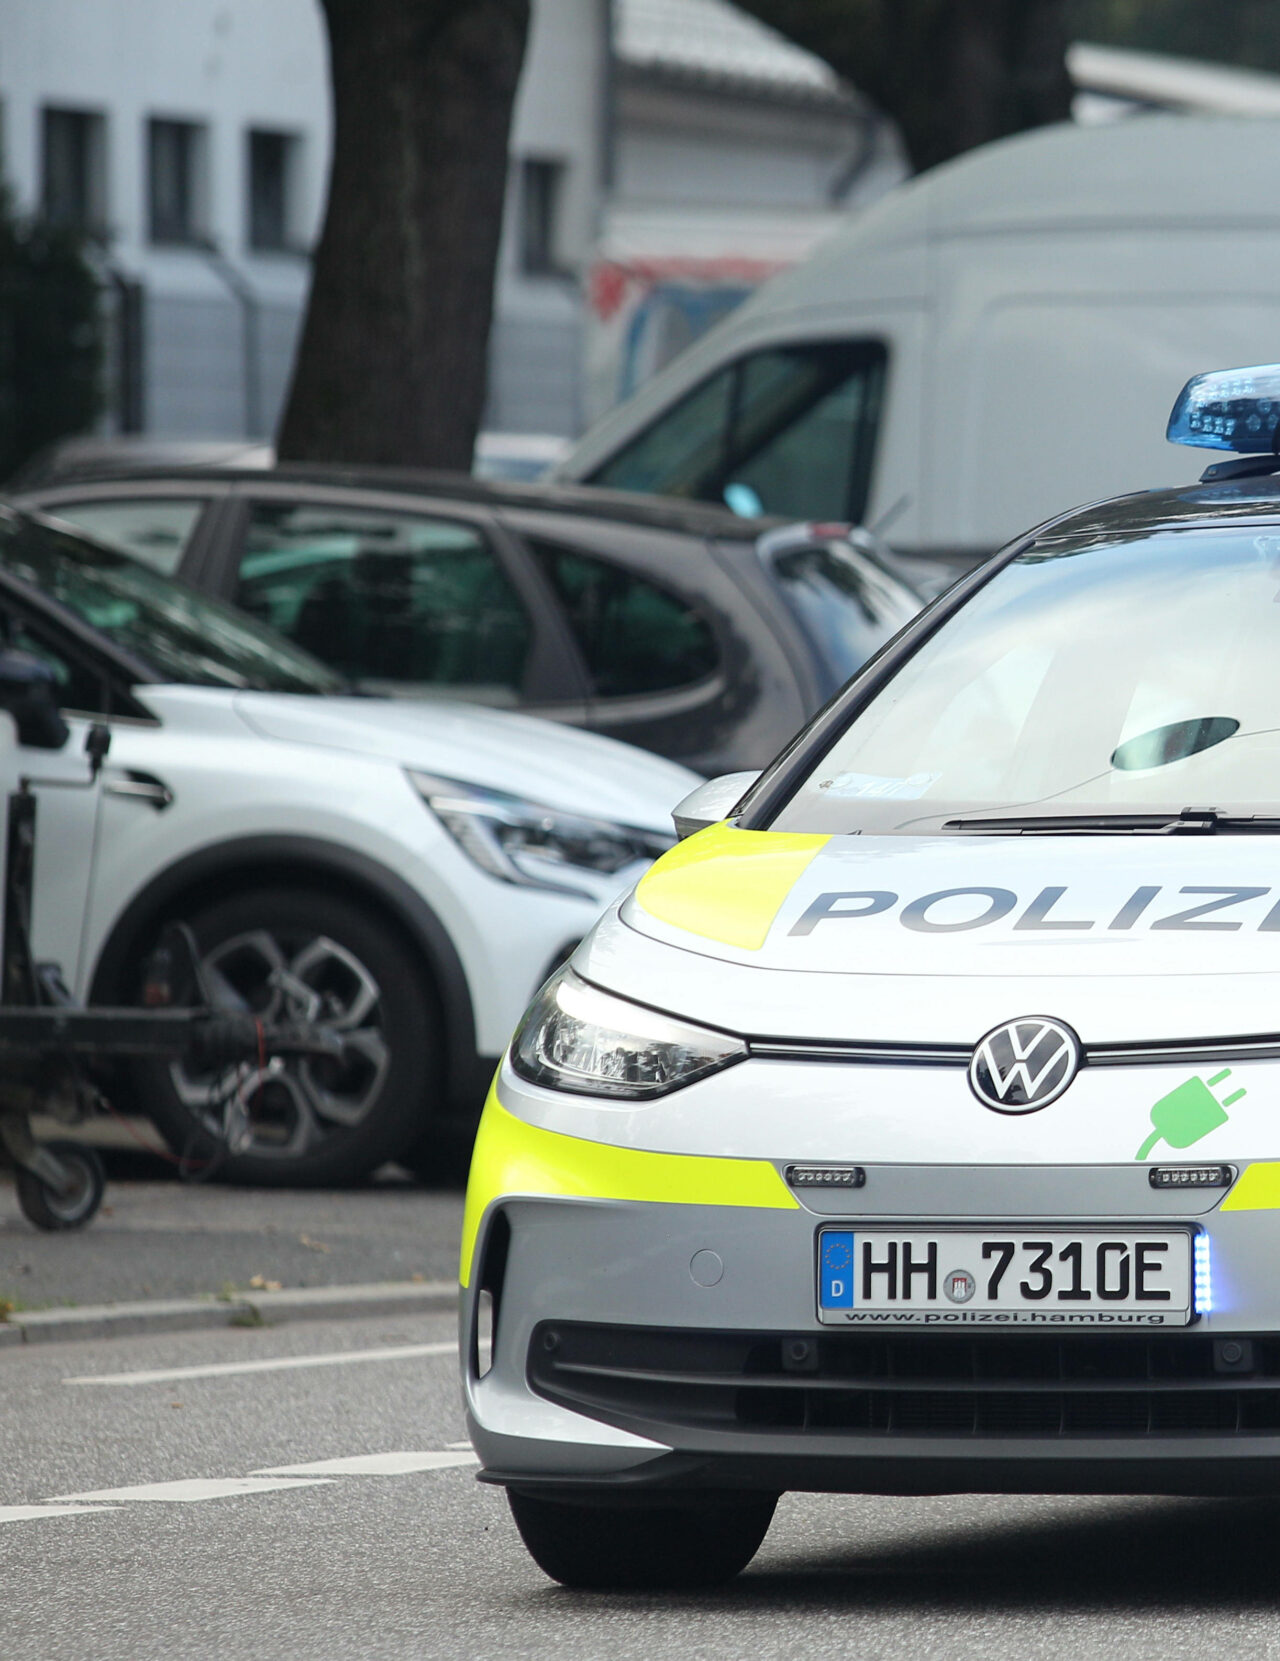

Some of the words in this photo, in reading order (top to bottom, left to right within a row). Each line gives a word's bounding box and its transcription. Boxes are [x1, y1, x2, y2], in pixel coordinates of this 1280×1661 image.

[978, 1023, 1071, 1100] VW
[831, 1280, 844, 1297] D
[862, 1241, 938, 1300] HH
[982, 1241, 1171, 1300] 7310E
[844, 1311, 1166, 1325] www.polizei.hamburg
